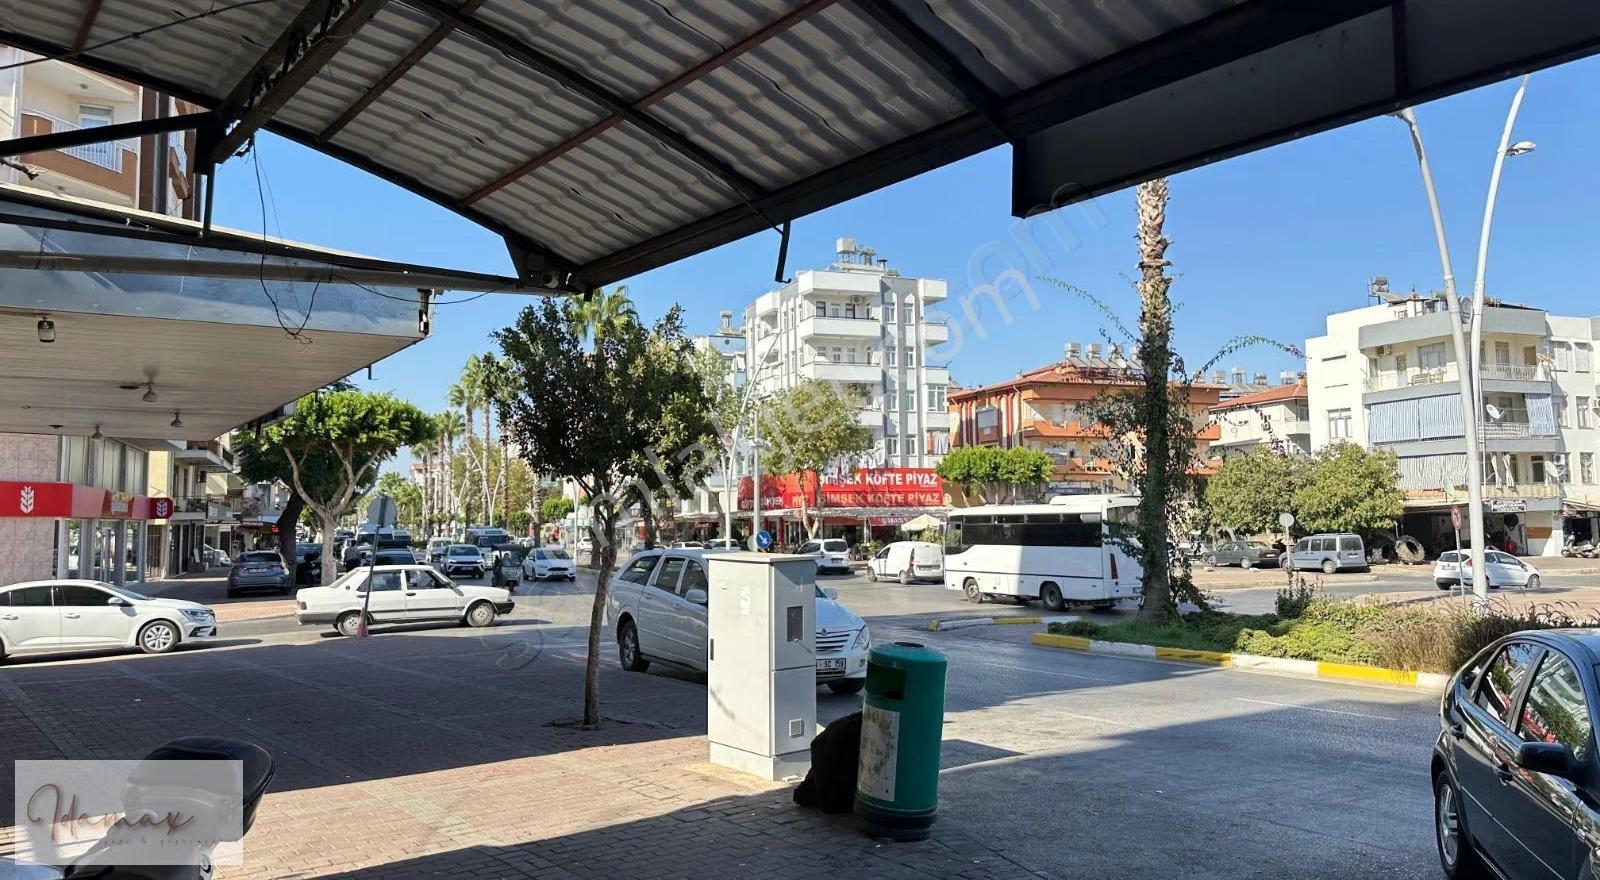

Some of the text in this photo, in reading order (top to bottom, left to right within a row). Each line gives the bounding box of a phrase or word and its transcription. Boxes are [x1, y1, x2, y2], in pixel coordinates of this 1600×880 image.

[865, 471, 903, 486] KÖFTE
[906, 470, 938, 485] PİYAZ
[792, 494, 809, 506] PİYZ
[867, 492, 904, 504] KÖFTE
[908, 492, 940, 503] PİYAZ
